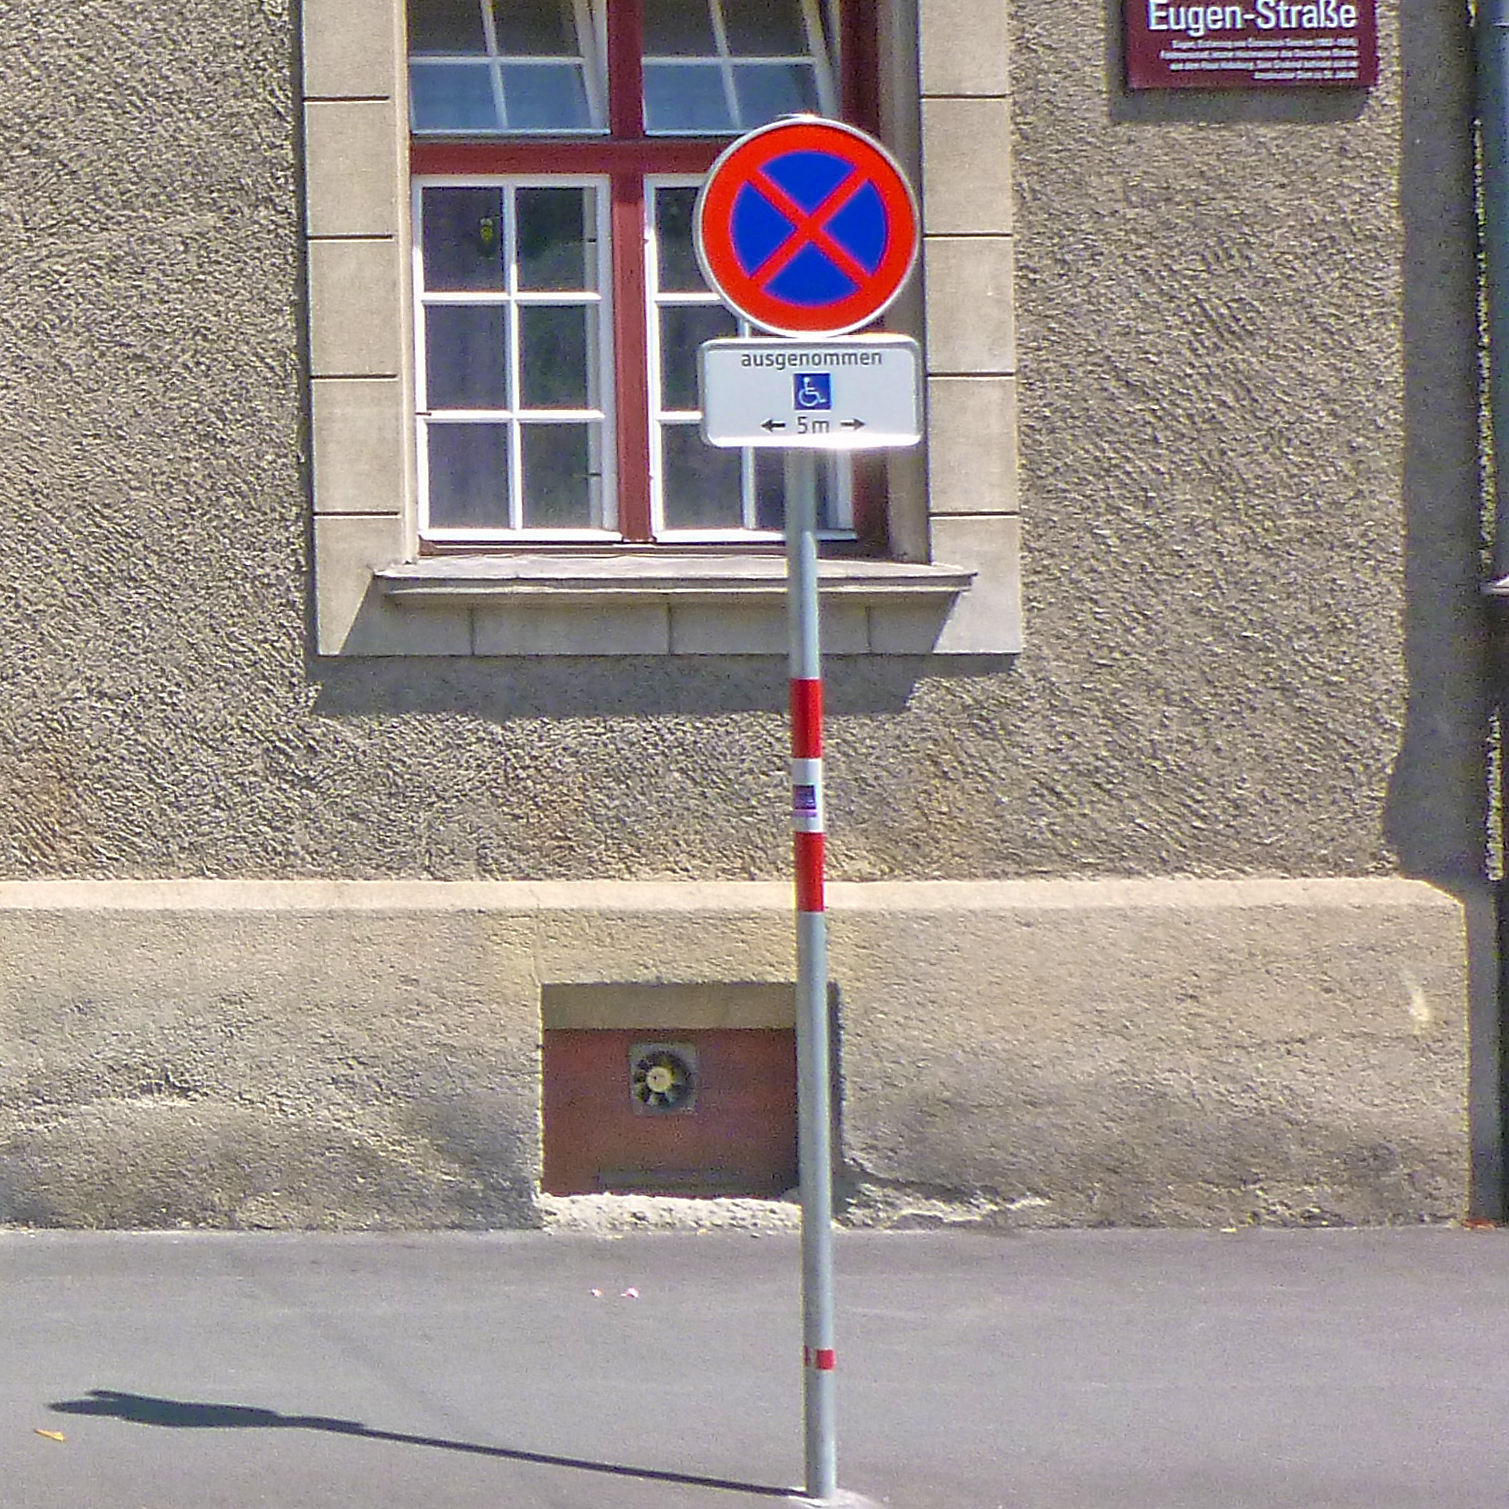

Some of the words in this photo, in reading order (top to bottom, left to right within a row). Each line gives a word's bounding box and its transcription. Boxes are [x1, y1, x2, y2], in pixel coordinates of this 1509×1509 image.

[741, 351, 882, 369] ausgenommen
[797, 416, 808, 434] 5
[812, 420, 829, 433] m
